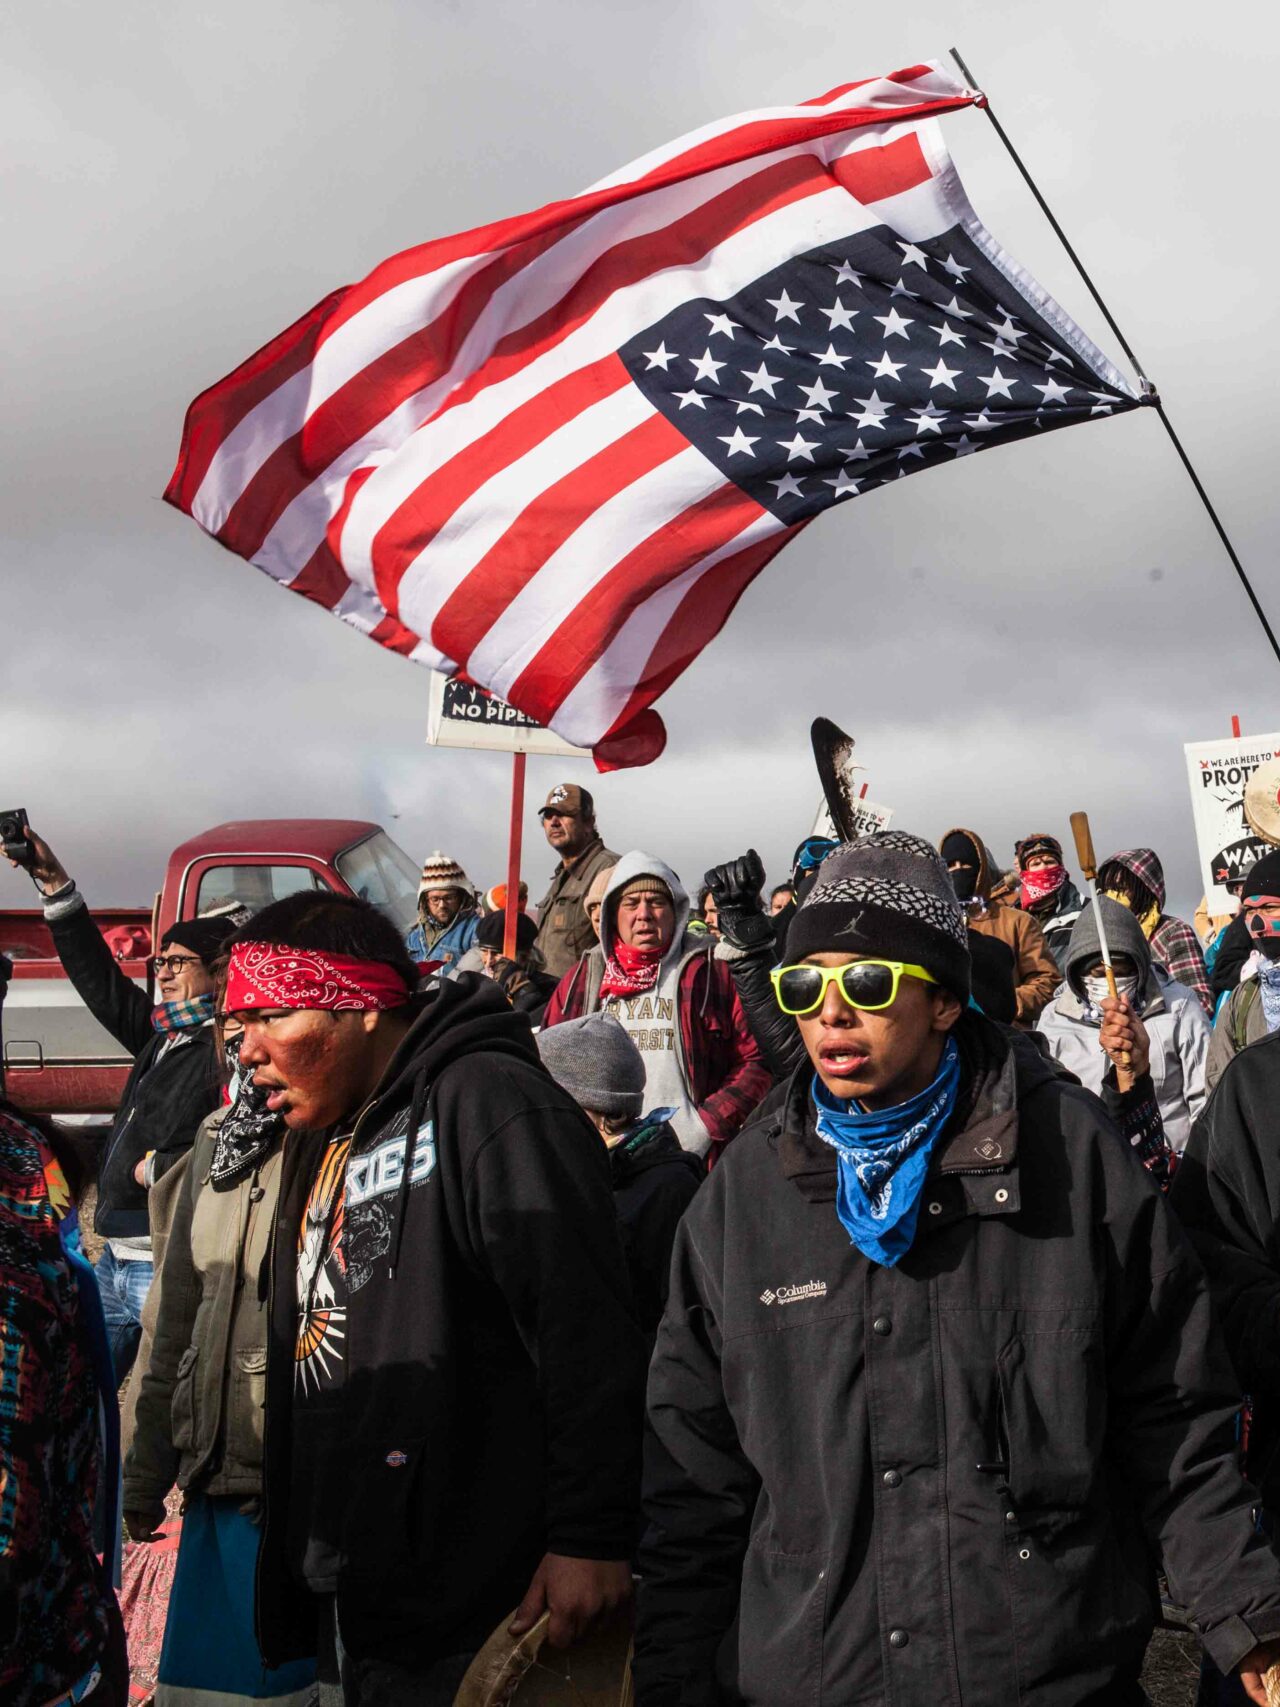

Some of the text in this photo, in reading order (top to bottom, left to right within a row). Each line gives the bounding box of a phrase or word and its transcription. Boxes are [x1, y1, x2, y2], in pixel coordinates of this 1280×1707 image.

[451, 703, 482, 718] NO
[1211, 752, 1272, 767] WE ARE HERE TO
[1202, 764, 1259, 788] PROT
[775, 1280, 827, 1299] Columbia
